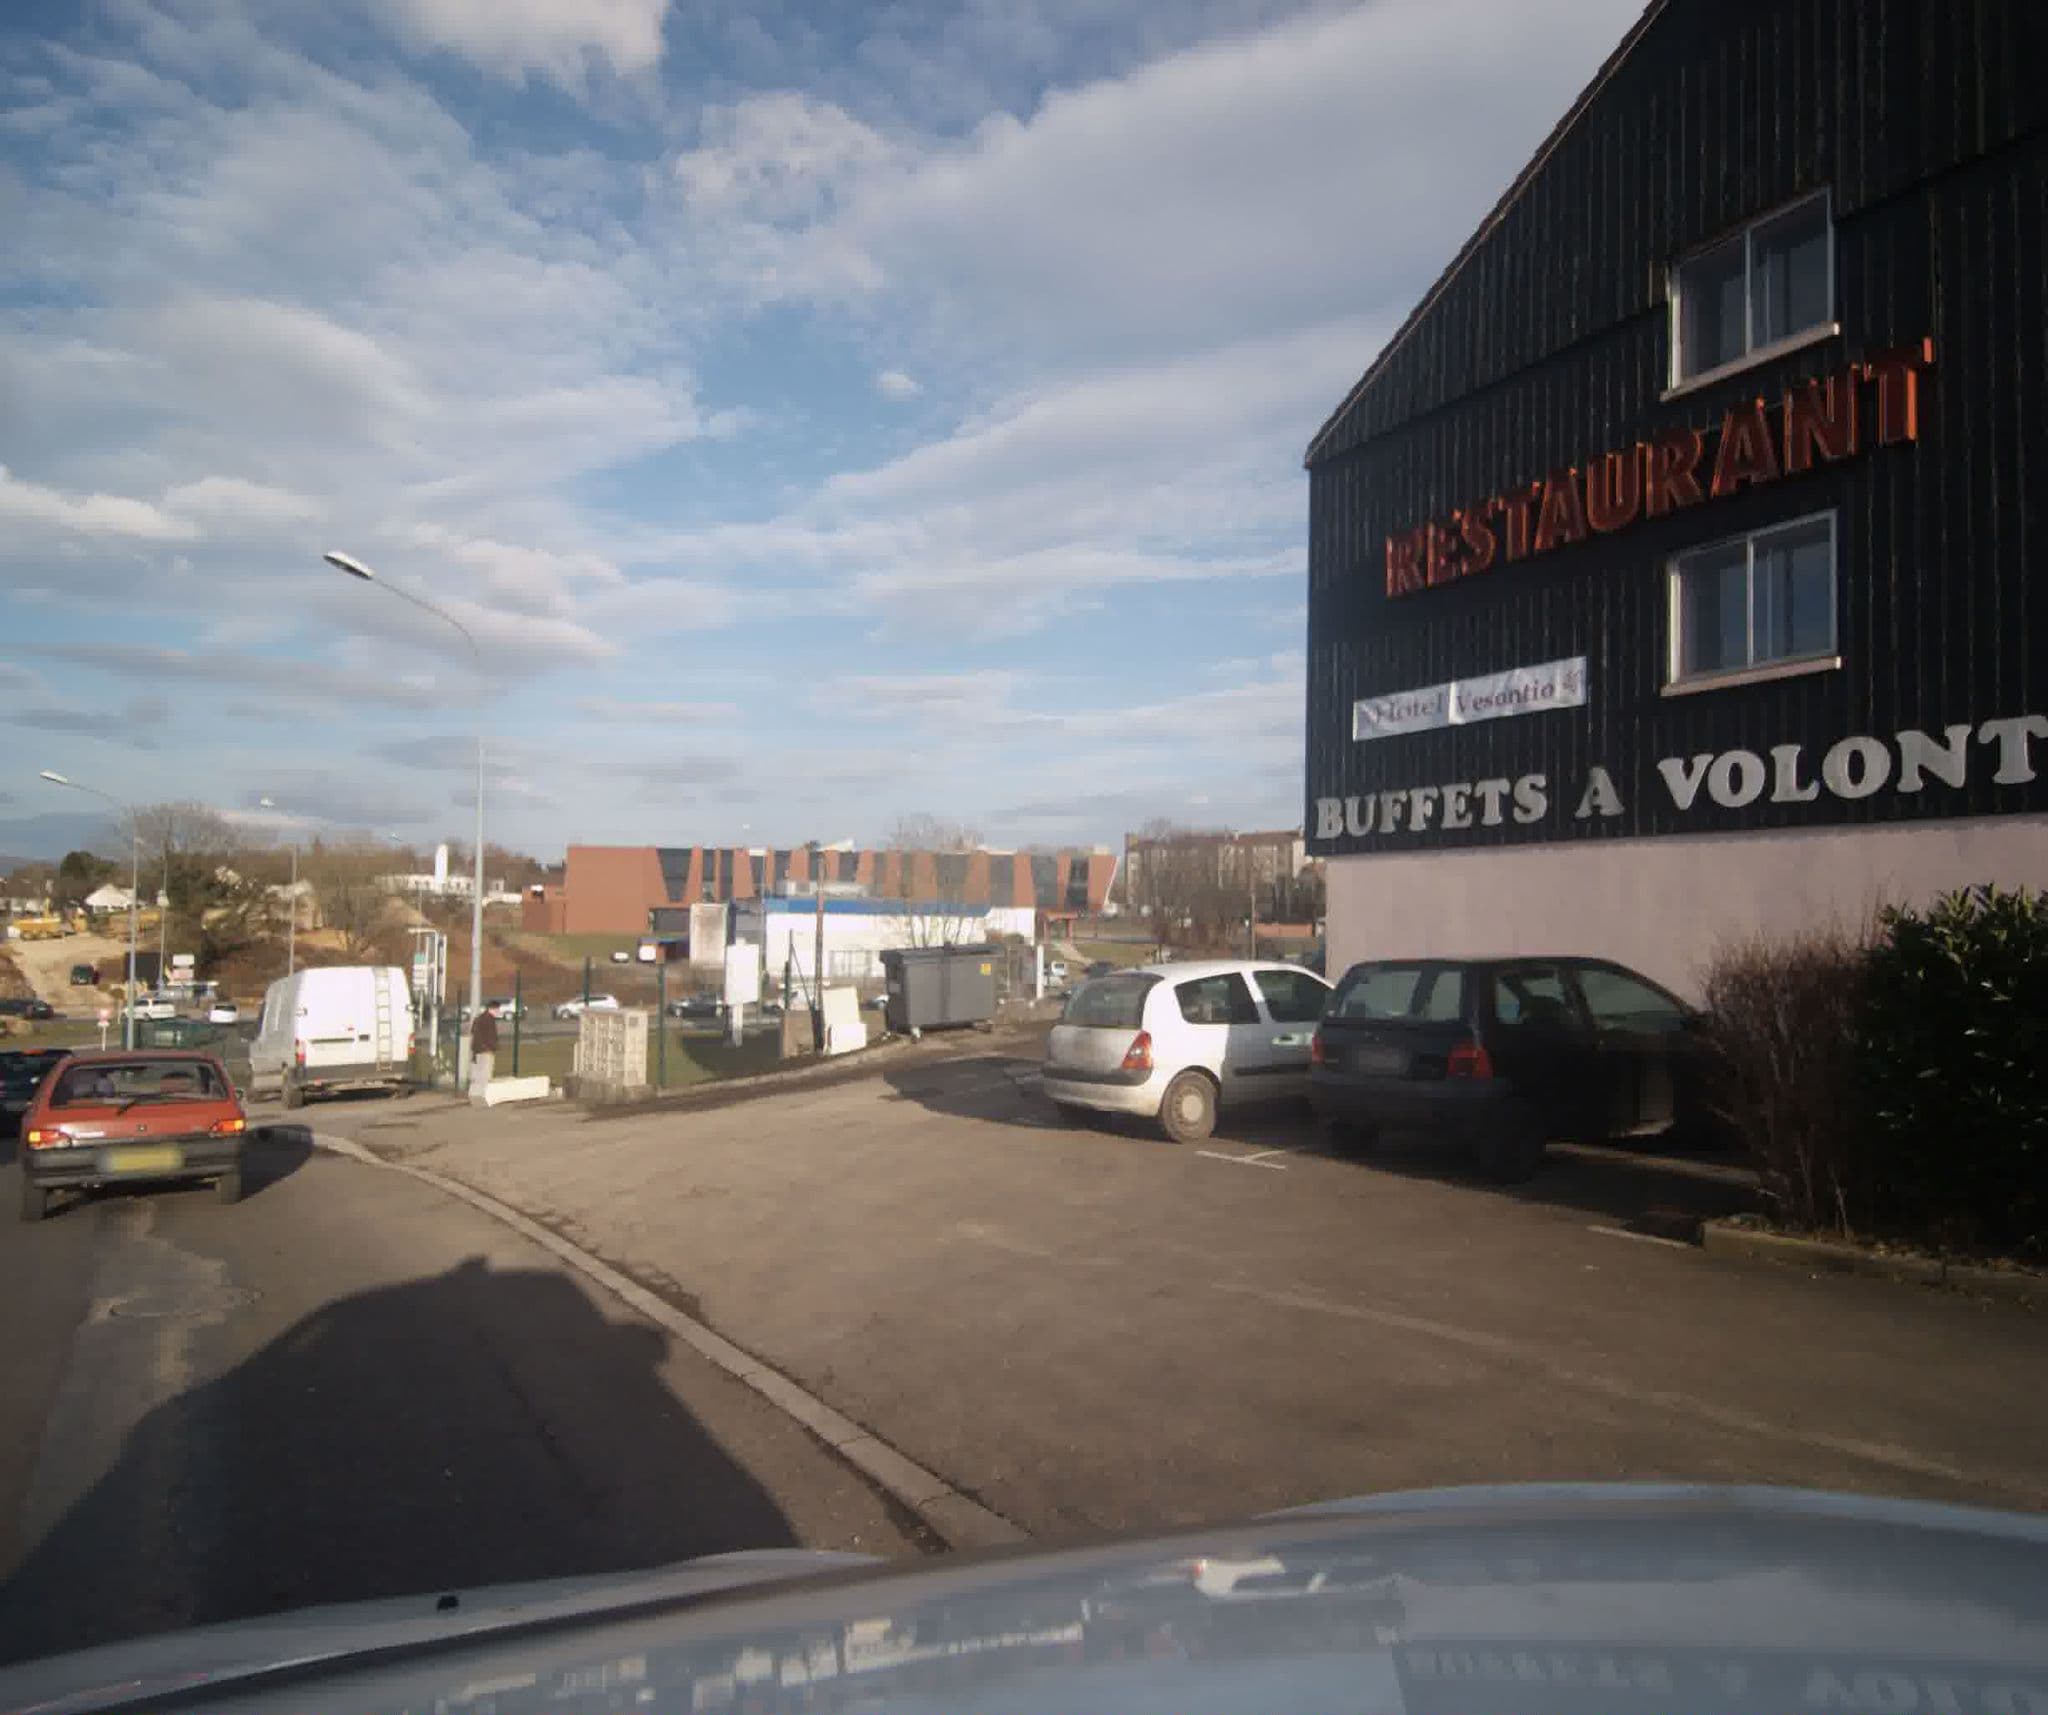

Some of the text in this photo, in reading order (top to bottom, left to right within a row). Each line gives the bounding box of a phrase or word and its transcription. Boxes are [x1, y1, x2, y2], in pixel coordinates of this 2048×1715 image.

[1385, 336, 1934, 599] RESTAURANT
[1316, 715, 2048, 839] BUFFETS A VOLONT
